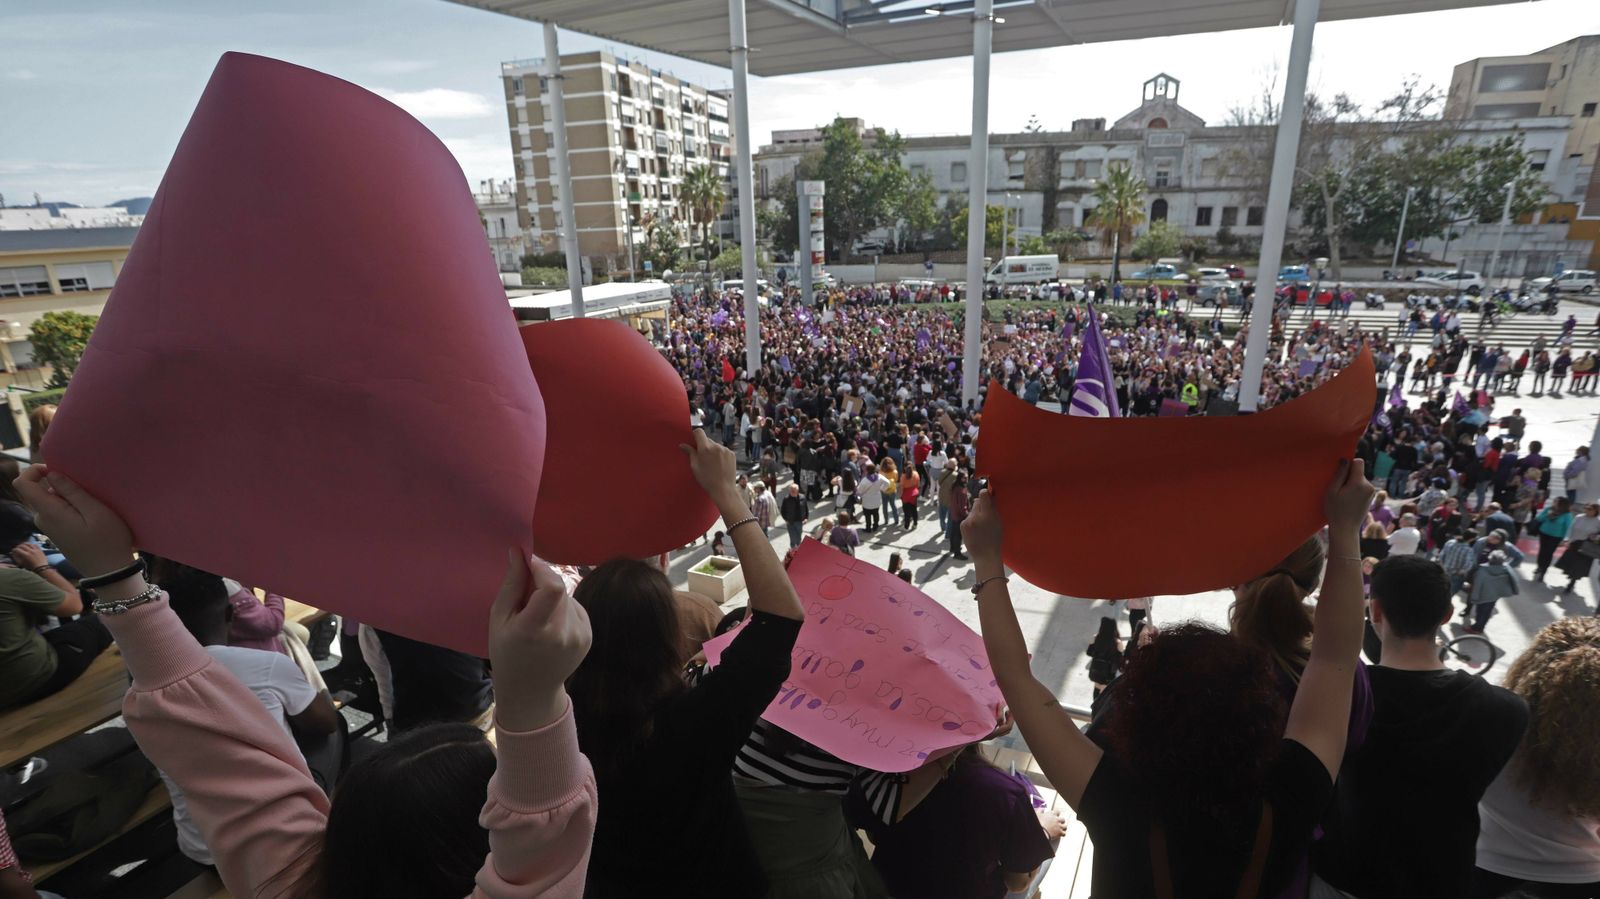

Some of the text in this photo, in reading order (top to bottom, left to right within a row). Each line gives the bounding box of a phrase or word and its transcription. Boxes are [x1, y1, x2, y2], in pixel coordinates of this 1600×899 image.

[807, 601, 834, 625] la
[875, 680, 903, 710] la
[840, 708, 897, 748] muy
